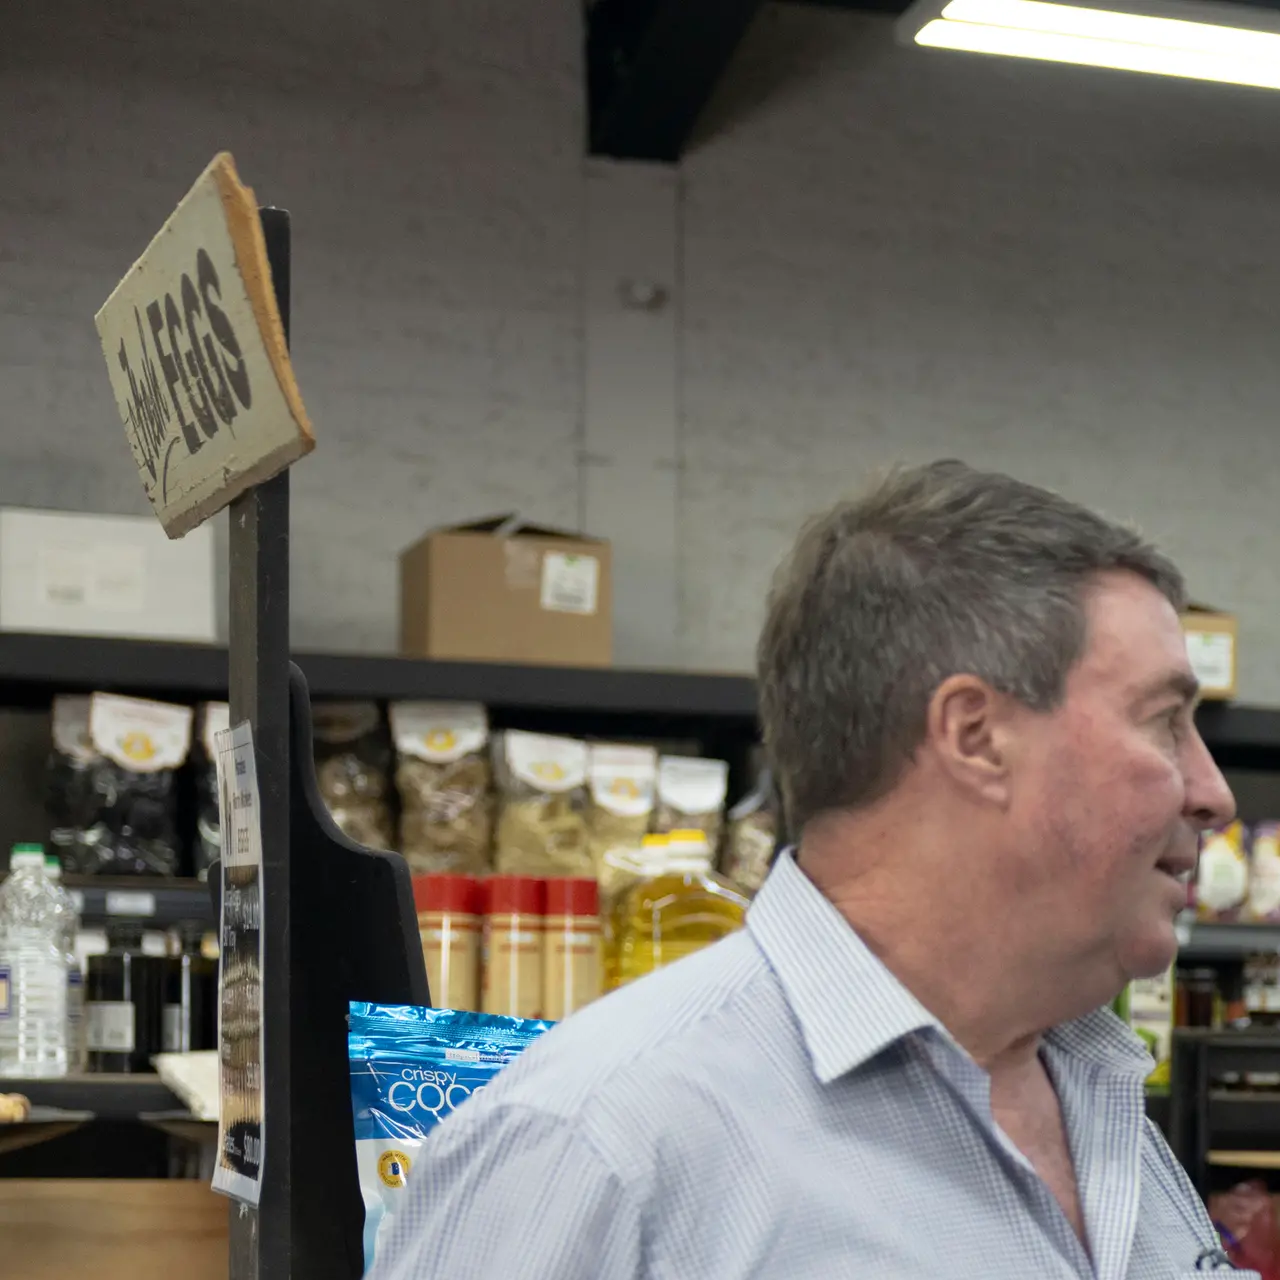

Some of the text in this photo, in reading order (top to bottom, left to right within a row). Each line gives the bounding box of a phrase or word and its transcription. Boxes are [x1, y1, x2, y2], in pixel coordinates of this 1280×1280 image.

[146, 248, 251, 455] EGGS
[401, 1067, 457, 1085] crispy
[388, 1081, 488, 1112] COC
